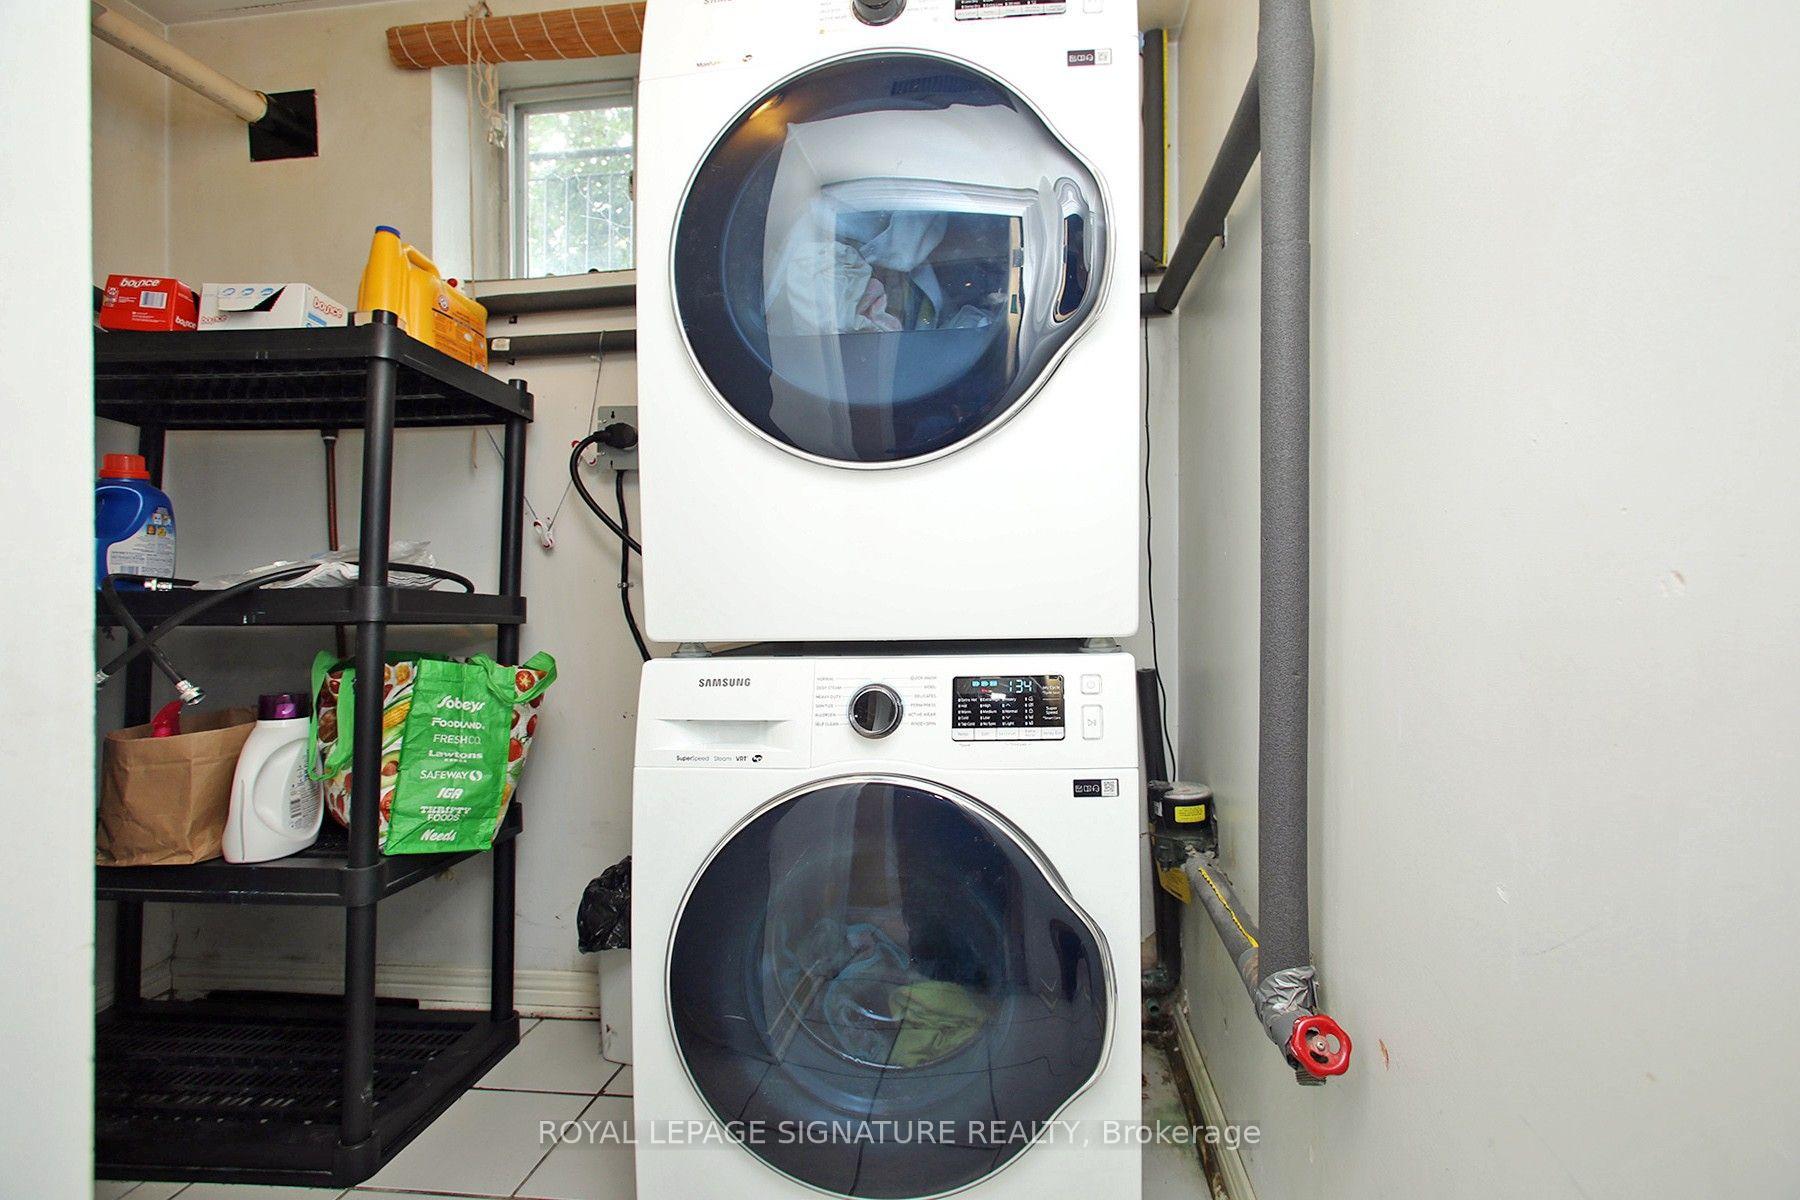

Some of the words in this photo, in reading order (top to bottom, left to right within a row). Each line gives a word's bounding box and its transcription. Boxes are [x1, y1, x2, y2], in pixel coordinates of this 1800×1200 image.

[120, 278, 160, 288] bounce
[313, 296, 343, 318] bounce
[175, 315, 197, 329] bounce
[699, 678, 751, 687] SAMSUNG
[437, 695, 485, 713] Sobeys
[428, 750, 483, 759] Lawtons
[420, 770, 469, 779] SAFEWAY
[436, 787, 464, 799] IGA
[420, 806, 472, 814] THRIFTY
[427, 813, 460, 821] FOODS
[420, 829, 457, 841] Needs
